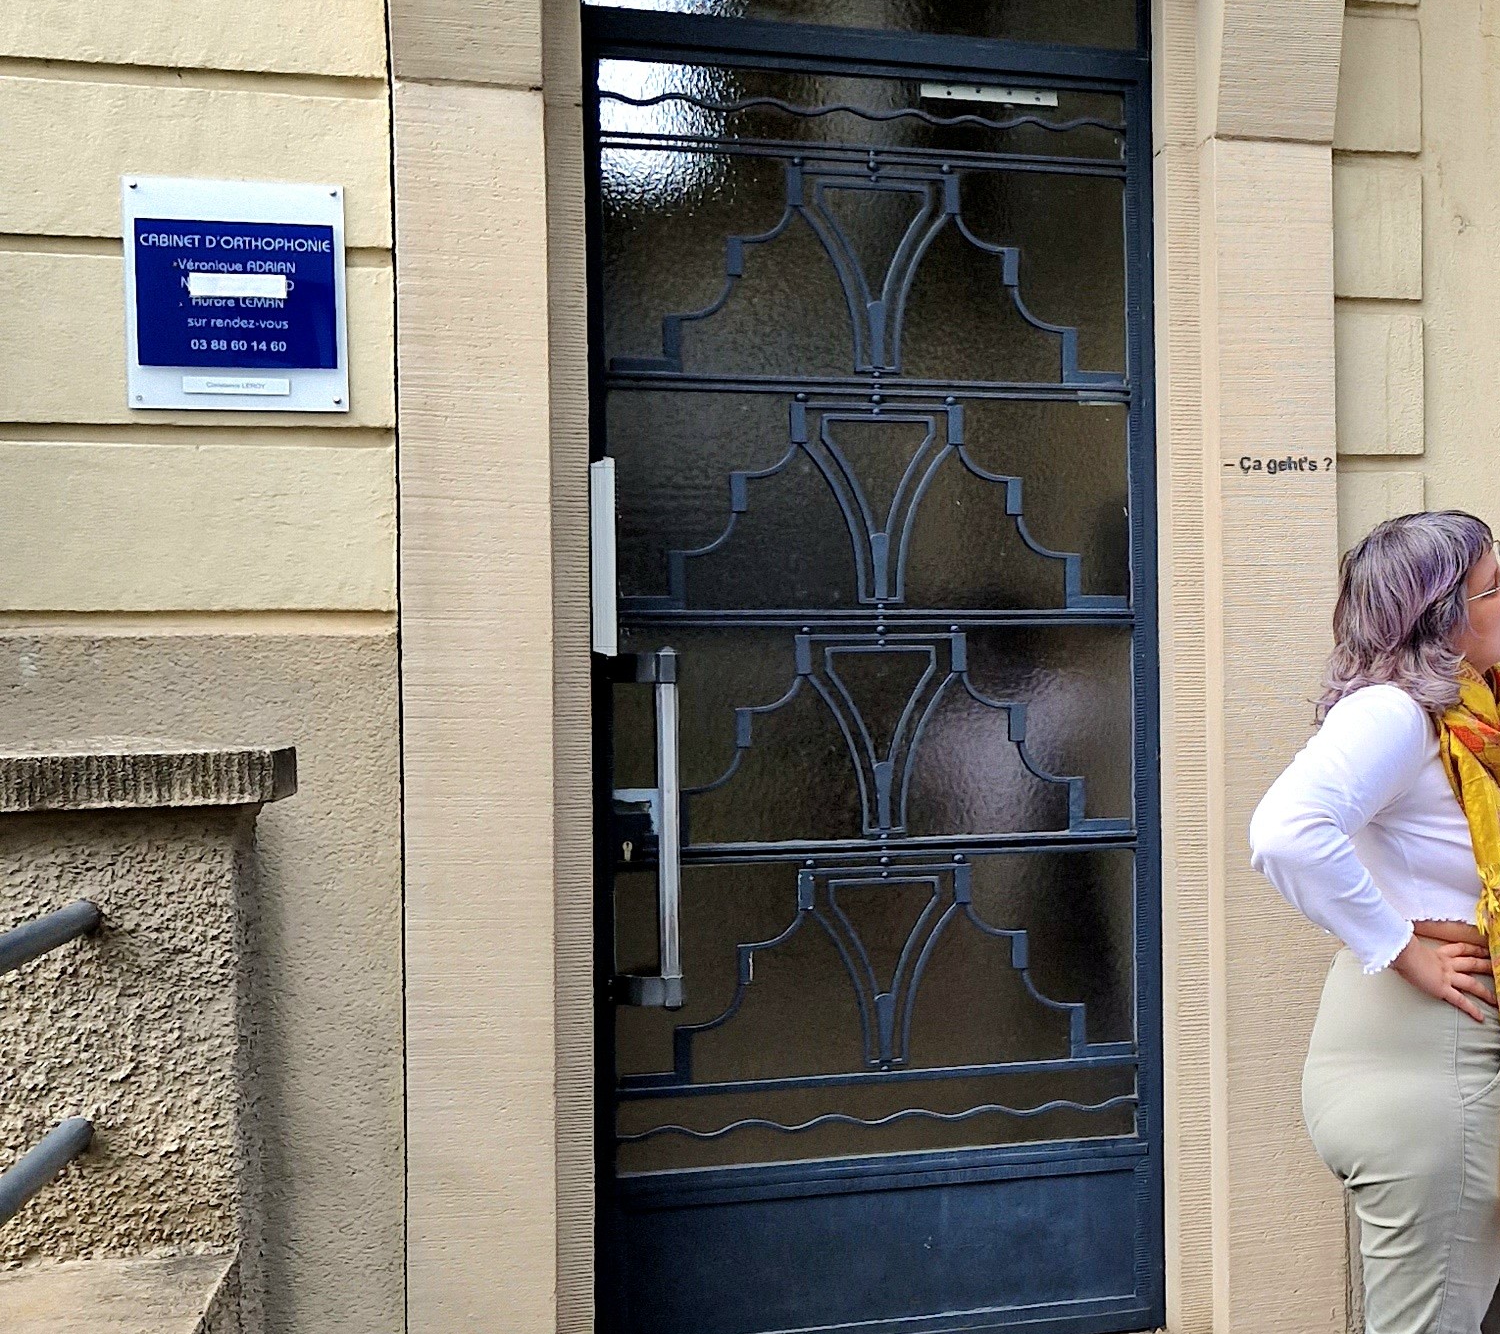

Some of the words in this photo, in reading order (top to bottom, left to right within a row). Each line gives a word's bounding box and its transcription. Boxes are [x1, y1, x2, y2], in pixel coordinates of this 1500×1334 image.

[140, 233, 202, 248] CABINET
[205, 235, 331, 253] D'ORTHOPHONIE
[177, 258, 244, 274] Véronique
[246, 260, 296, 274] ADRIAN
[187, 317, 208, 327] sur
[210, 315, 289, 329] rendez-vous
[190, 339, 208, 350] 03
[210, 339, 228, 351] 88
[230, 340, 248, 351] 60
[250, 340, 267, 352] 14
[270, 340, 287, 352] 60
[1239, 456, 1262, 474] Ça
[1266, 456, 1318, 475] geht's
[1323, 456, 1333, 472] ?
